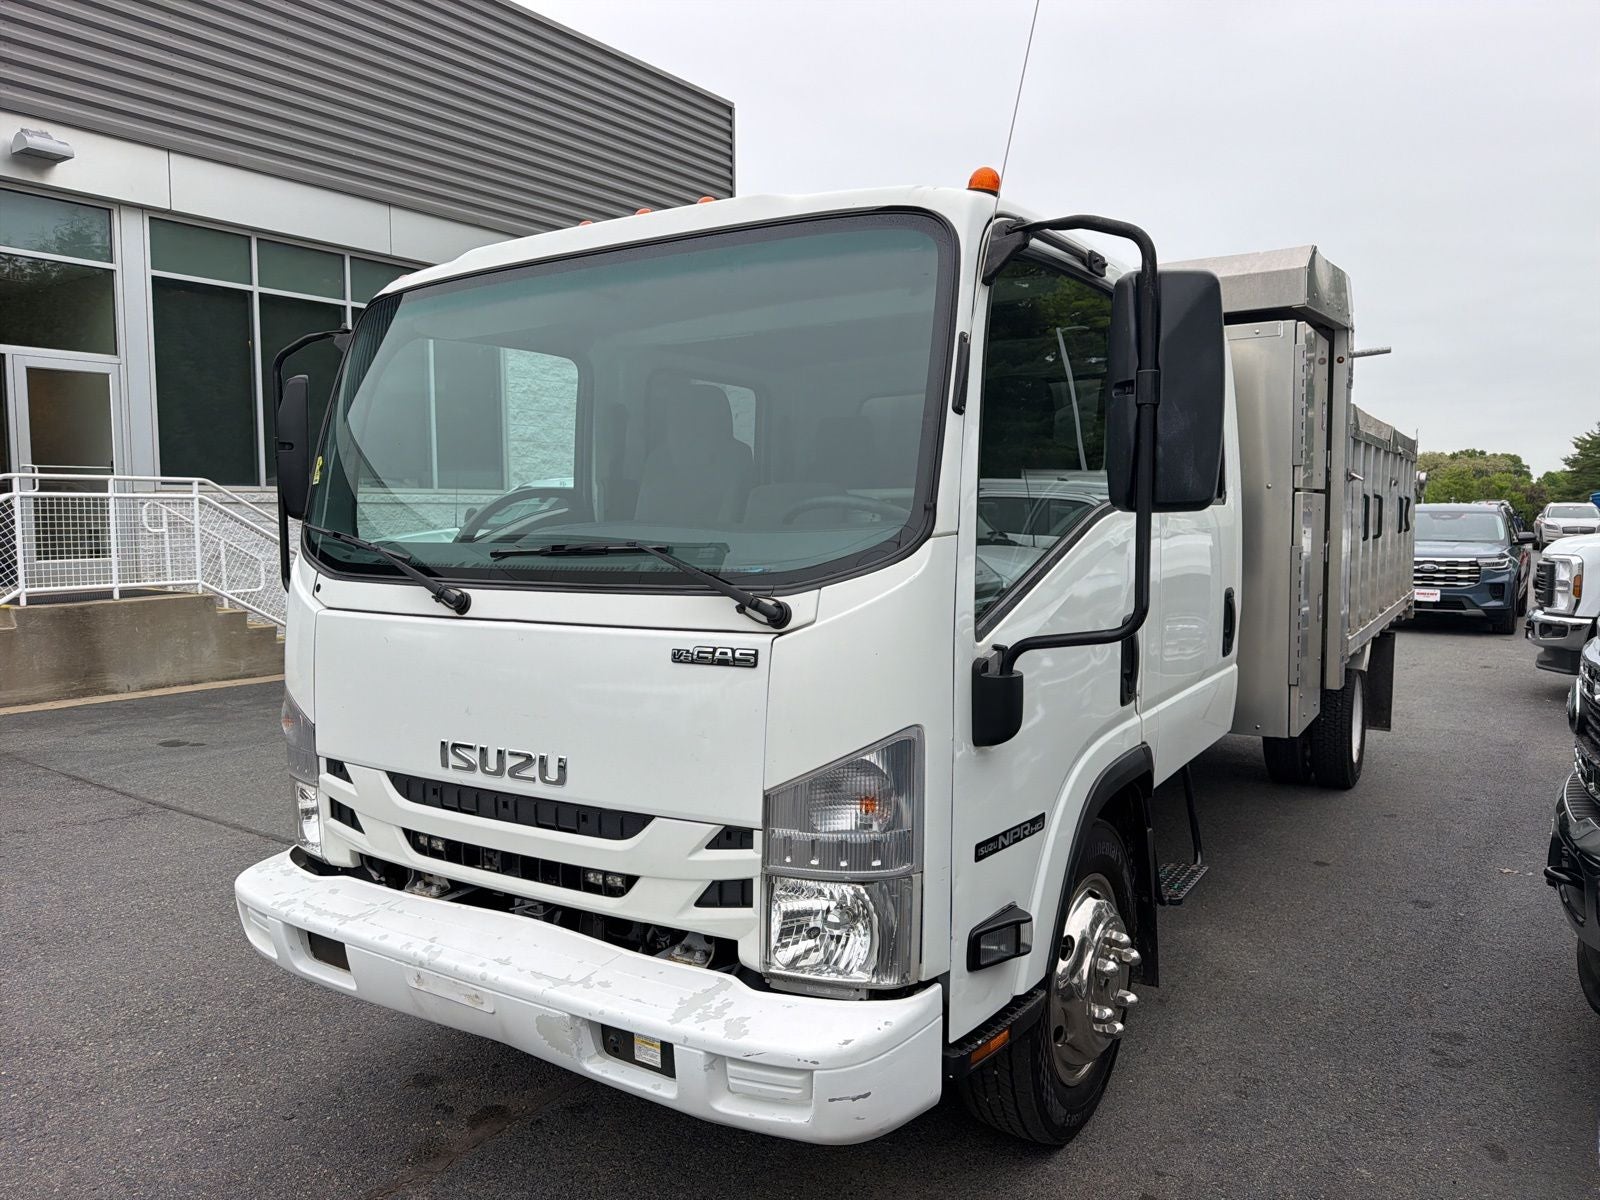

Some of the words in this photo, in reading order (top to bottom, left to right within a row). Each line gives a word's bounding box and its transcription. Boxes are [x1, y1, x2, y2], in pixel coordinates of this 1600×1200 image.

[692, 646, 758, 668] GAS
[440, 739, 567, 788] ISUZU
[977, 841, 998, 856] ISUZU
[998, 823, 1031, 849] NPR
